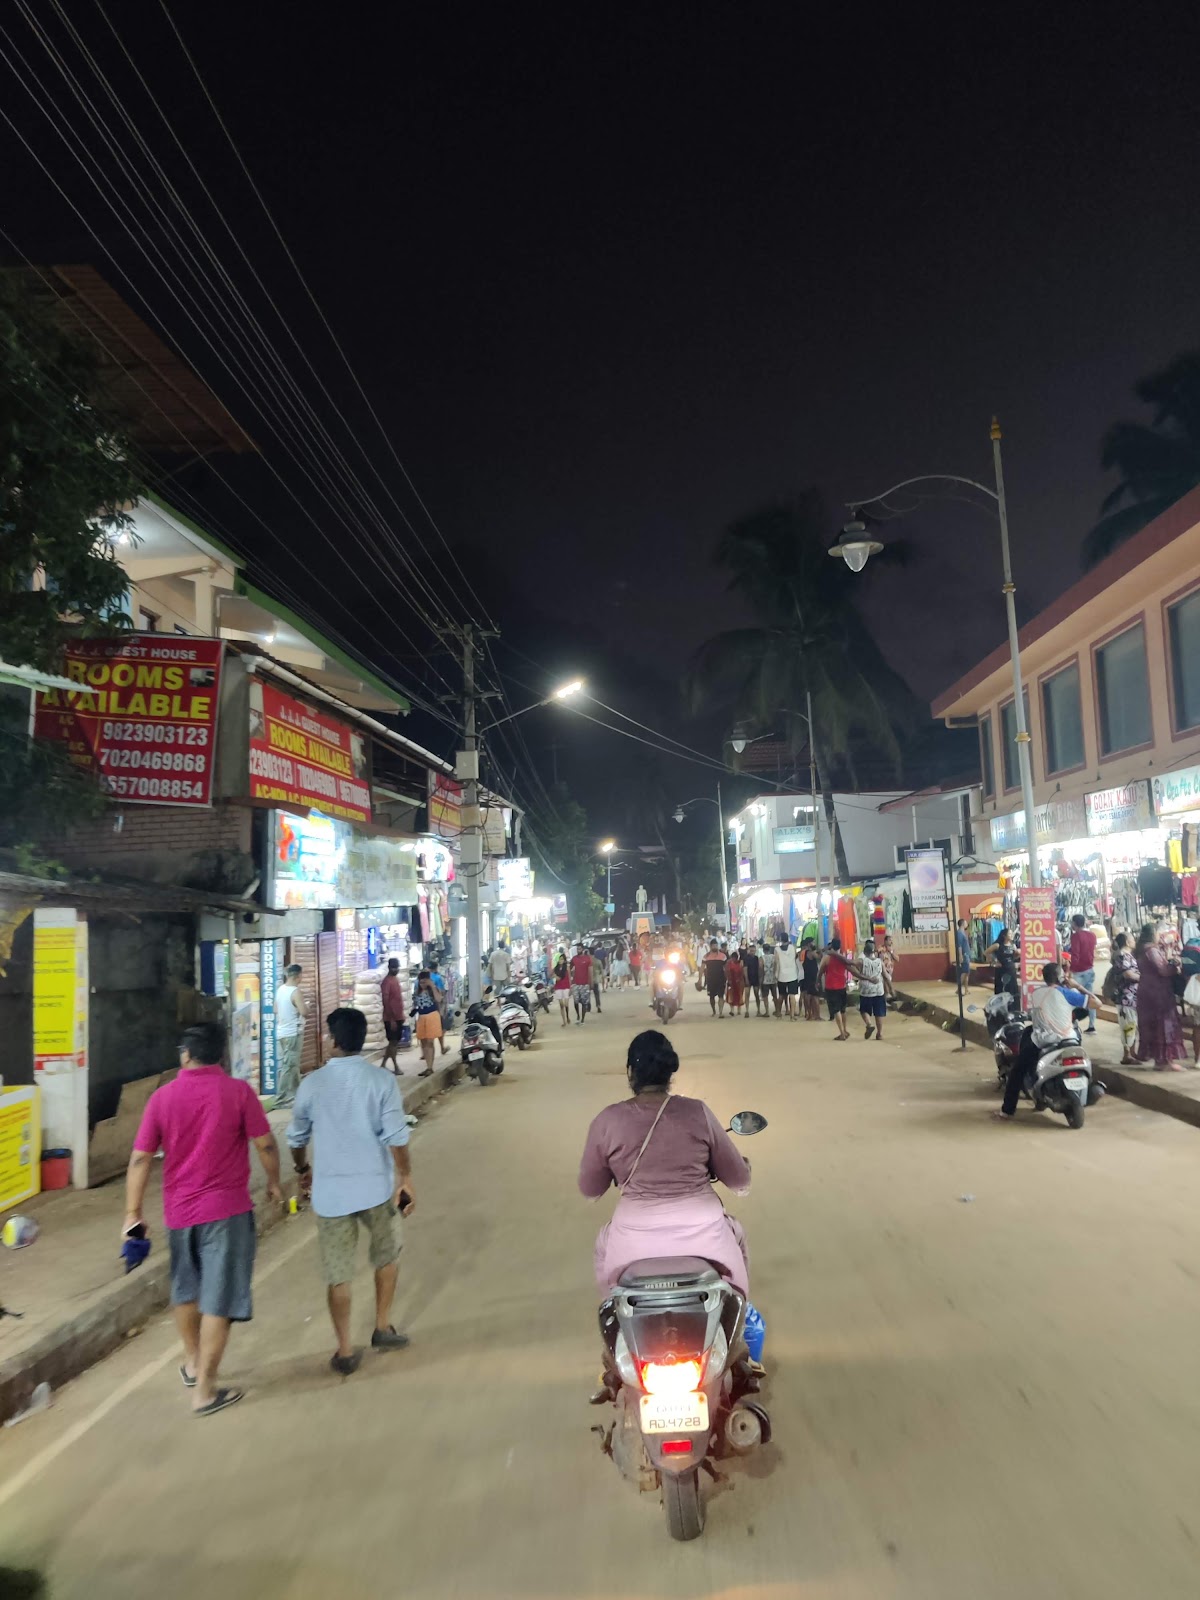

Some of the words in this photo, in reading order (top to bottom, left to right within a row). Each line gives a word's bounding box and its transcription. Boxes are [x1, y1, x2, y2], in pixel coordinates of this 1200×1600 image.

[151, 648, 197, 660] HOUSE
[67, 660, 184, 690] ROOMS
[42, 688, 211, 720] AVAILABLE
[103, 722, 208, 746] 9823903123
[302, 716, 321, 736] GUEST
[321, 725, 341, 746] HOUSE
[100, 749, 205, 772] 7020469868
[270, 722, 307, 757] ROOMS
[309, 740, 352, 775] AVAILABLE
[1093, 791, 1114, 810] GOAN
[1116, 785, 1138, 807] KAJU
[777, 826, 812, 836] ALEX'S
[263, 940, 274, 1006] DUDHSAGAR
[263, 1013, 275, 1090] WATERFALLS
